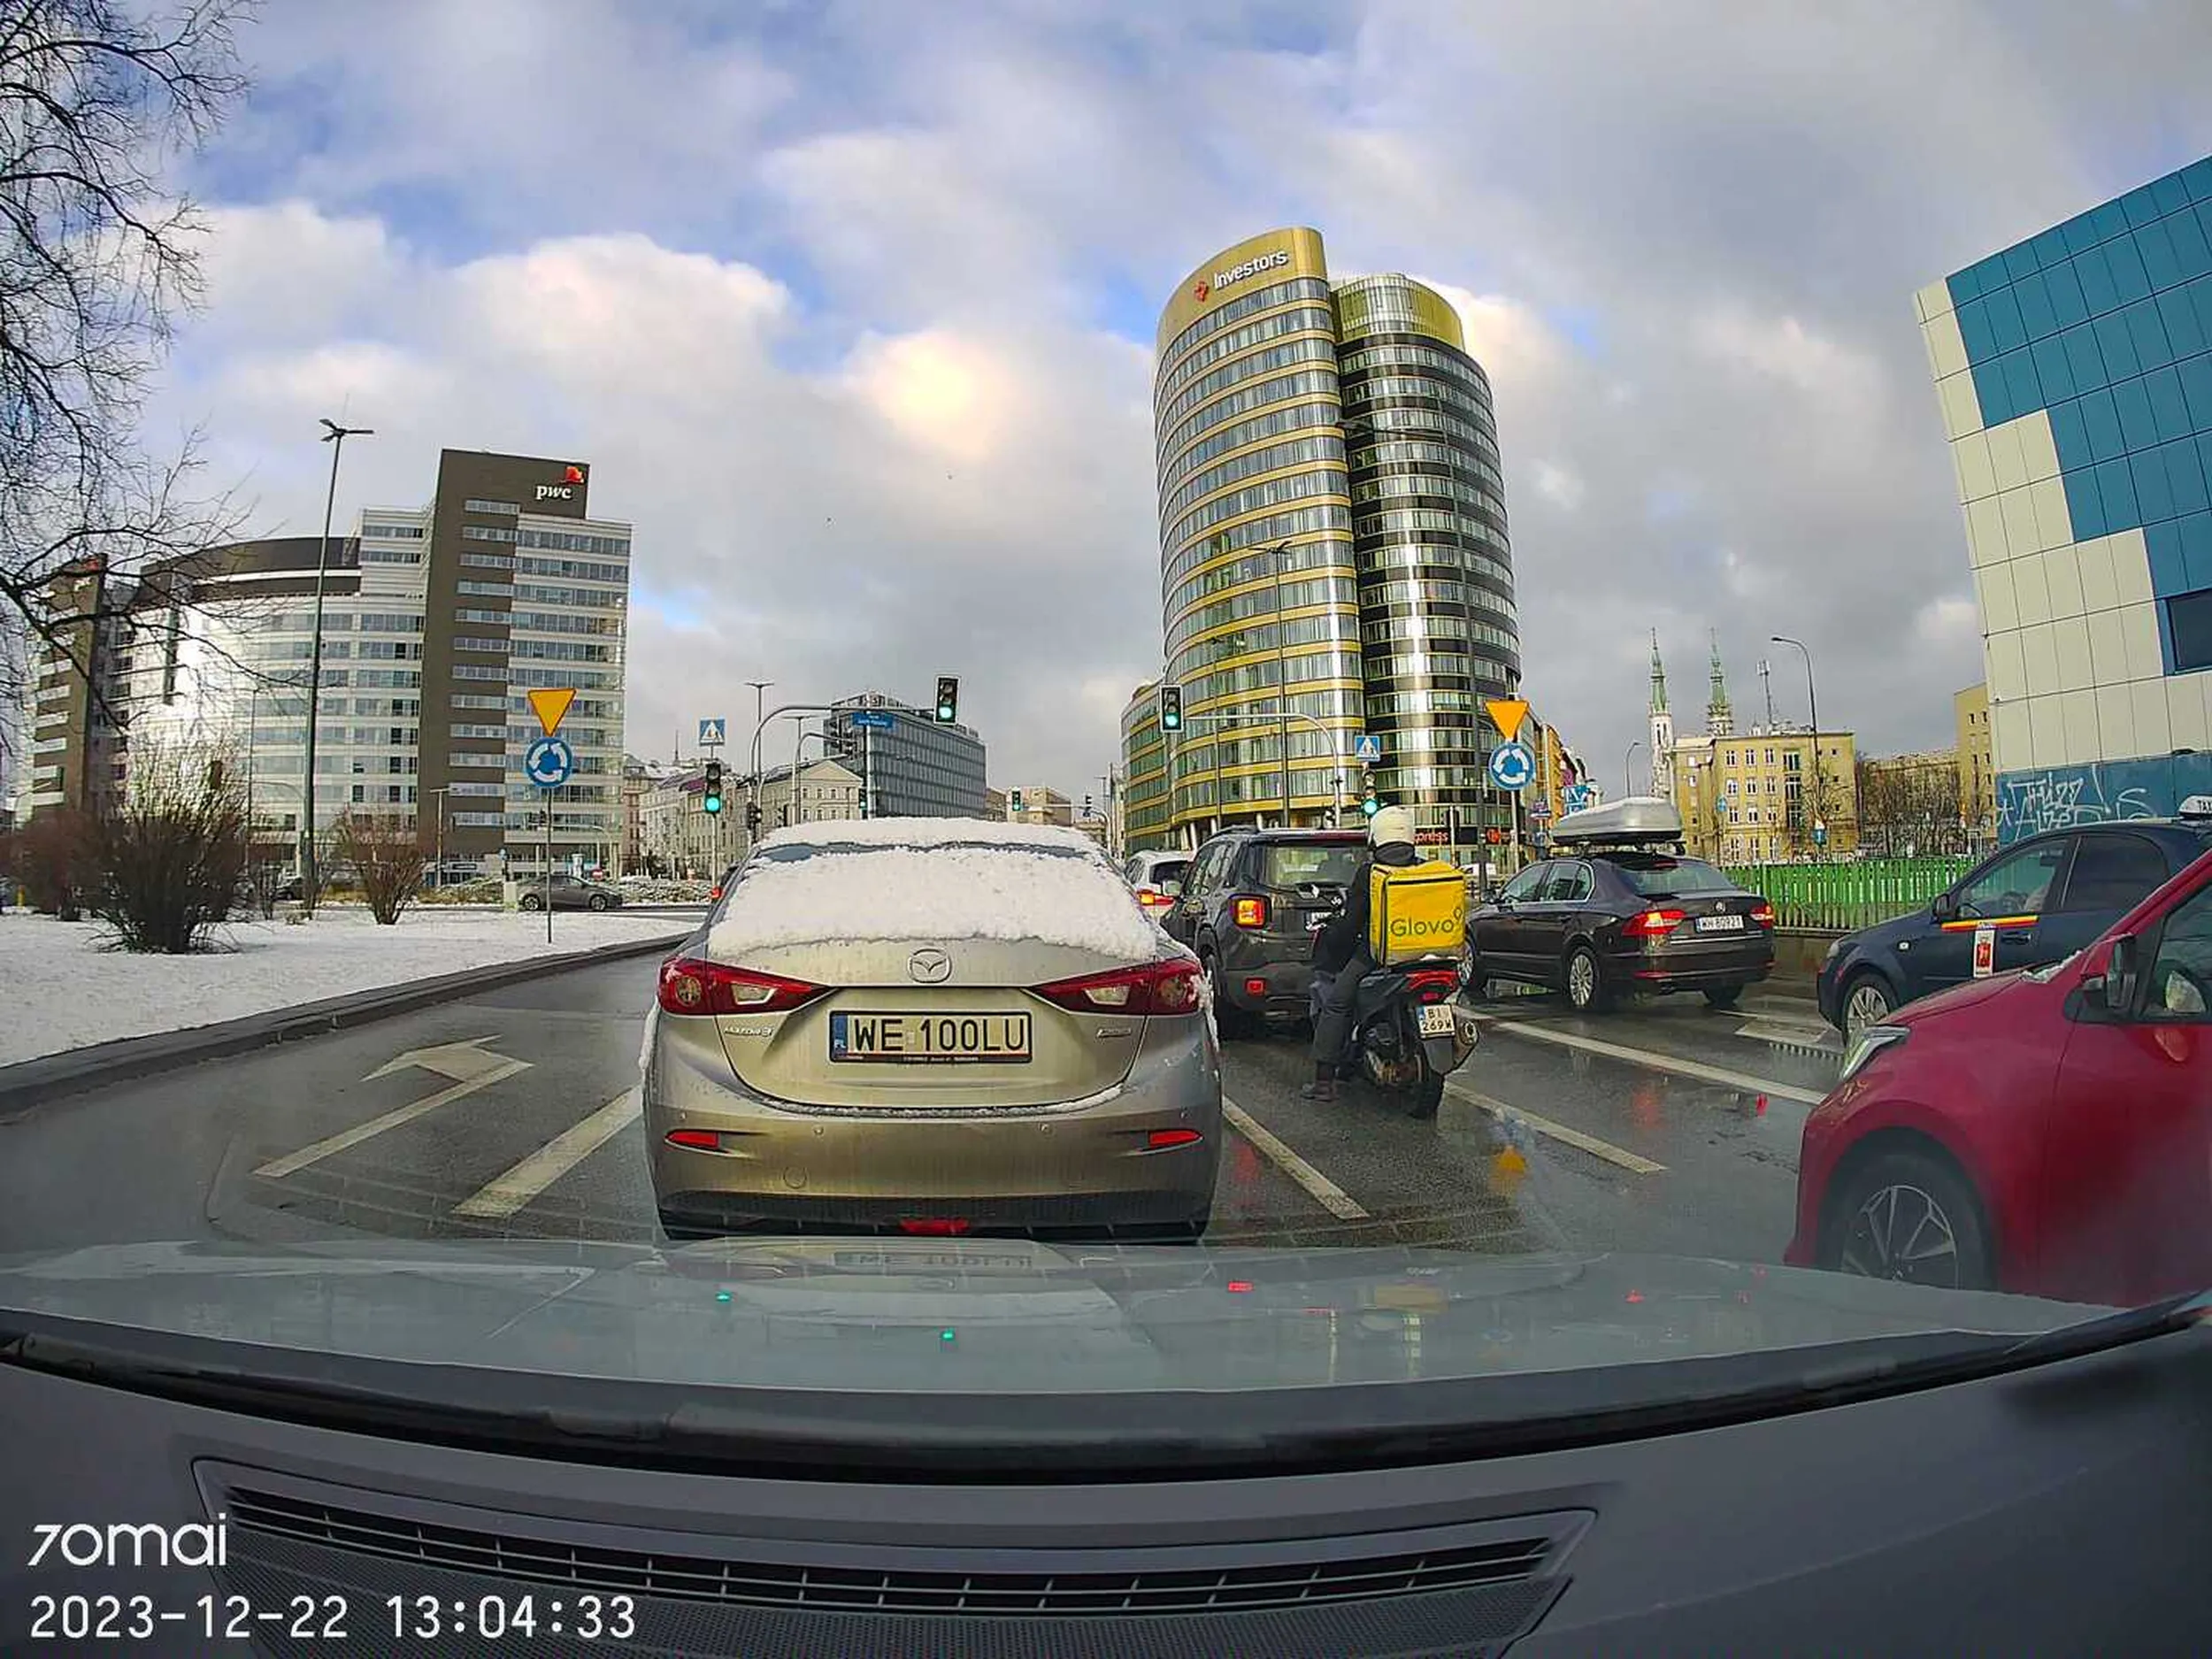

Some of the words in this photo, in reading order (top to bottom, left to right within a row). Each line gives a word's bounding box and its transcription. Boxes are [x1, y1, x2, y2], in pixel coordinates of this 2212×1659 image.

[1213, 250, 1289, 289] Investors
[534, 485, 572, 501] pwc
[1413, 832, 1449, 845] press
[1390, 917, 1455, 937] Glovo
[855, 1019, 902, 1051] WE
[920, 1019, 1025, 1051] 100LU
